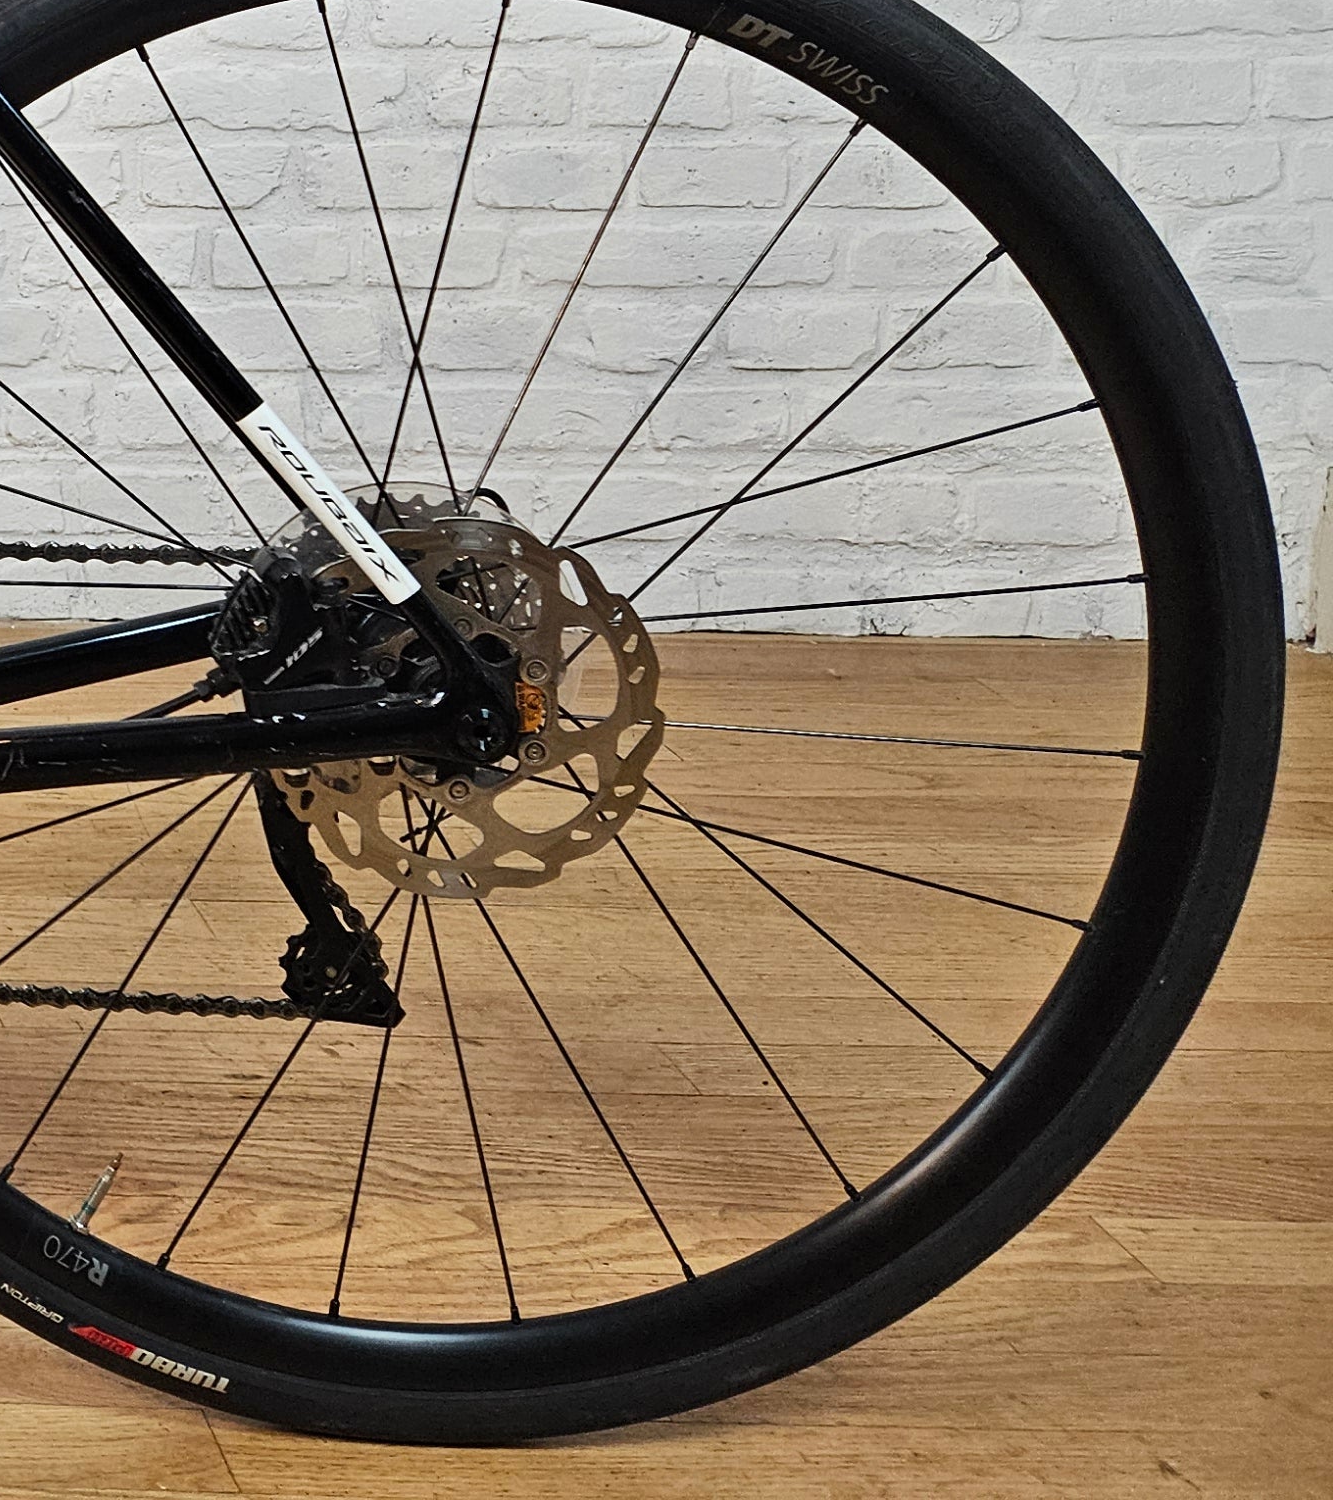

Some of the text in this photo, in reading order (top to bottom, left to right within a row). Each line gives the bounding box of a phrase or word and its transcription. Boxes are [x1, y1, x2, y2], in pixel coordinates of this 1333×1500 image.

[727, 13, 889, 105] DT SWISS
[258, 425, 400, 583] ROUBAIX
[43, 1235, 110, 1288] R470
[0, 1282, 230, 1394] TURBO GRIPTON
